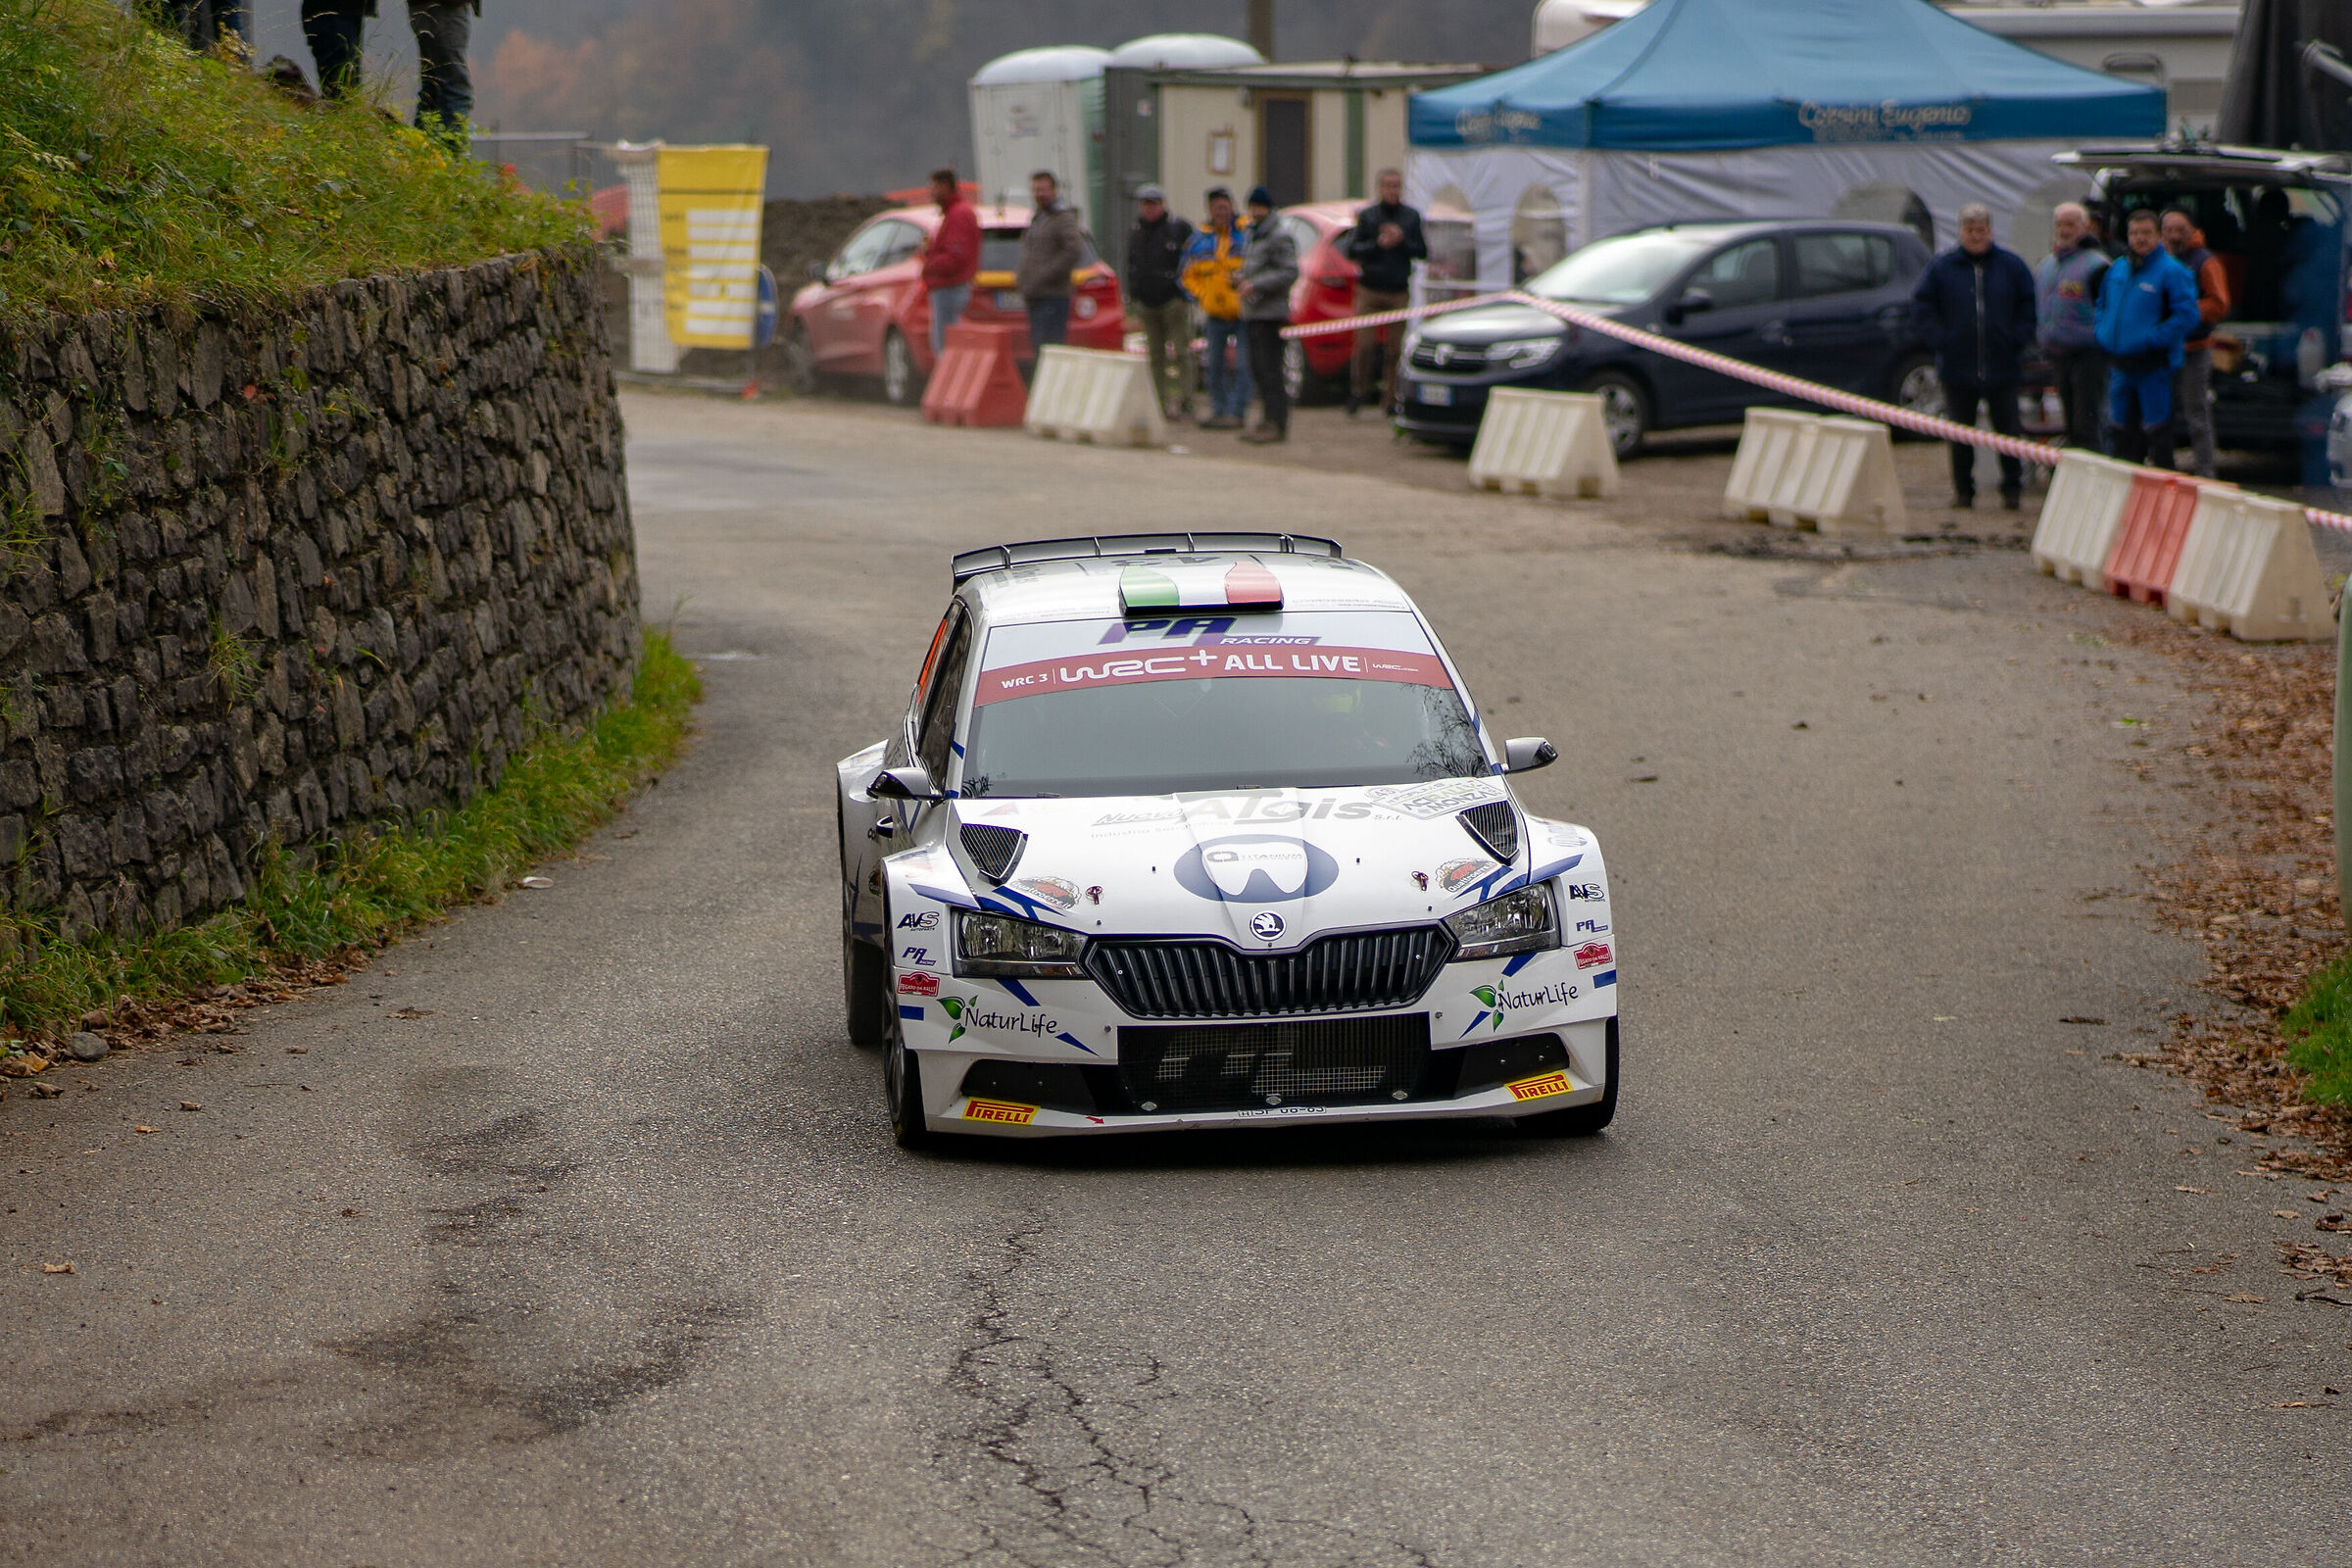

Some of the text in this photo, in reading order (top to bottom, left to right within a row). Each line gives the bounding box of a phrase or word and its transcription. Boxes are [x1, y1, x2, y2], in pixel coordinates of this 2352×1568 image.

[1219, 636, 1312, 645] RACING
[1001, 674, 1035, 689] WRC
[1038, 673, 1049, 683] 3
[1224, 654, 1284, 670] ALL
[1291, 655, 1362, 672] LIVE
[1426, 790, 1494, 811] MONZA
[1568, 882, 1605, 901] AVS
[896, 910, 941, 930] AVS
[1497, 981, 1579, 1010] NaturLife
[964, 1005, 1058, 1038] NaturLife
[1507, 1074, 1569, 1100] PIRELLI
[965, 1100, 1035, 1124] PIRELLI
